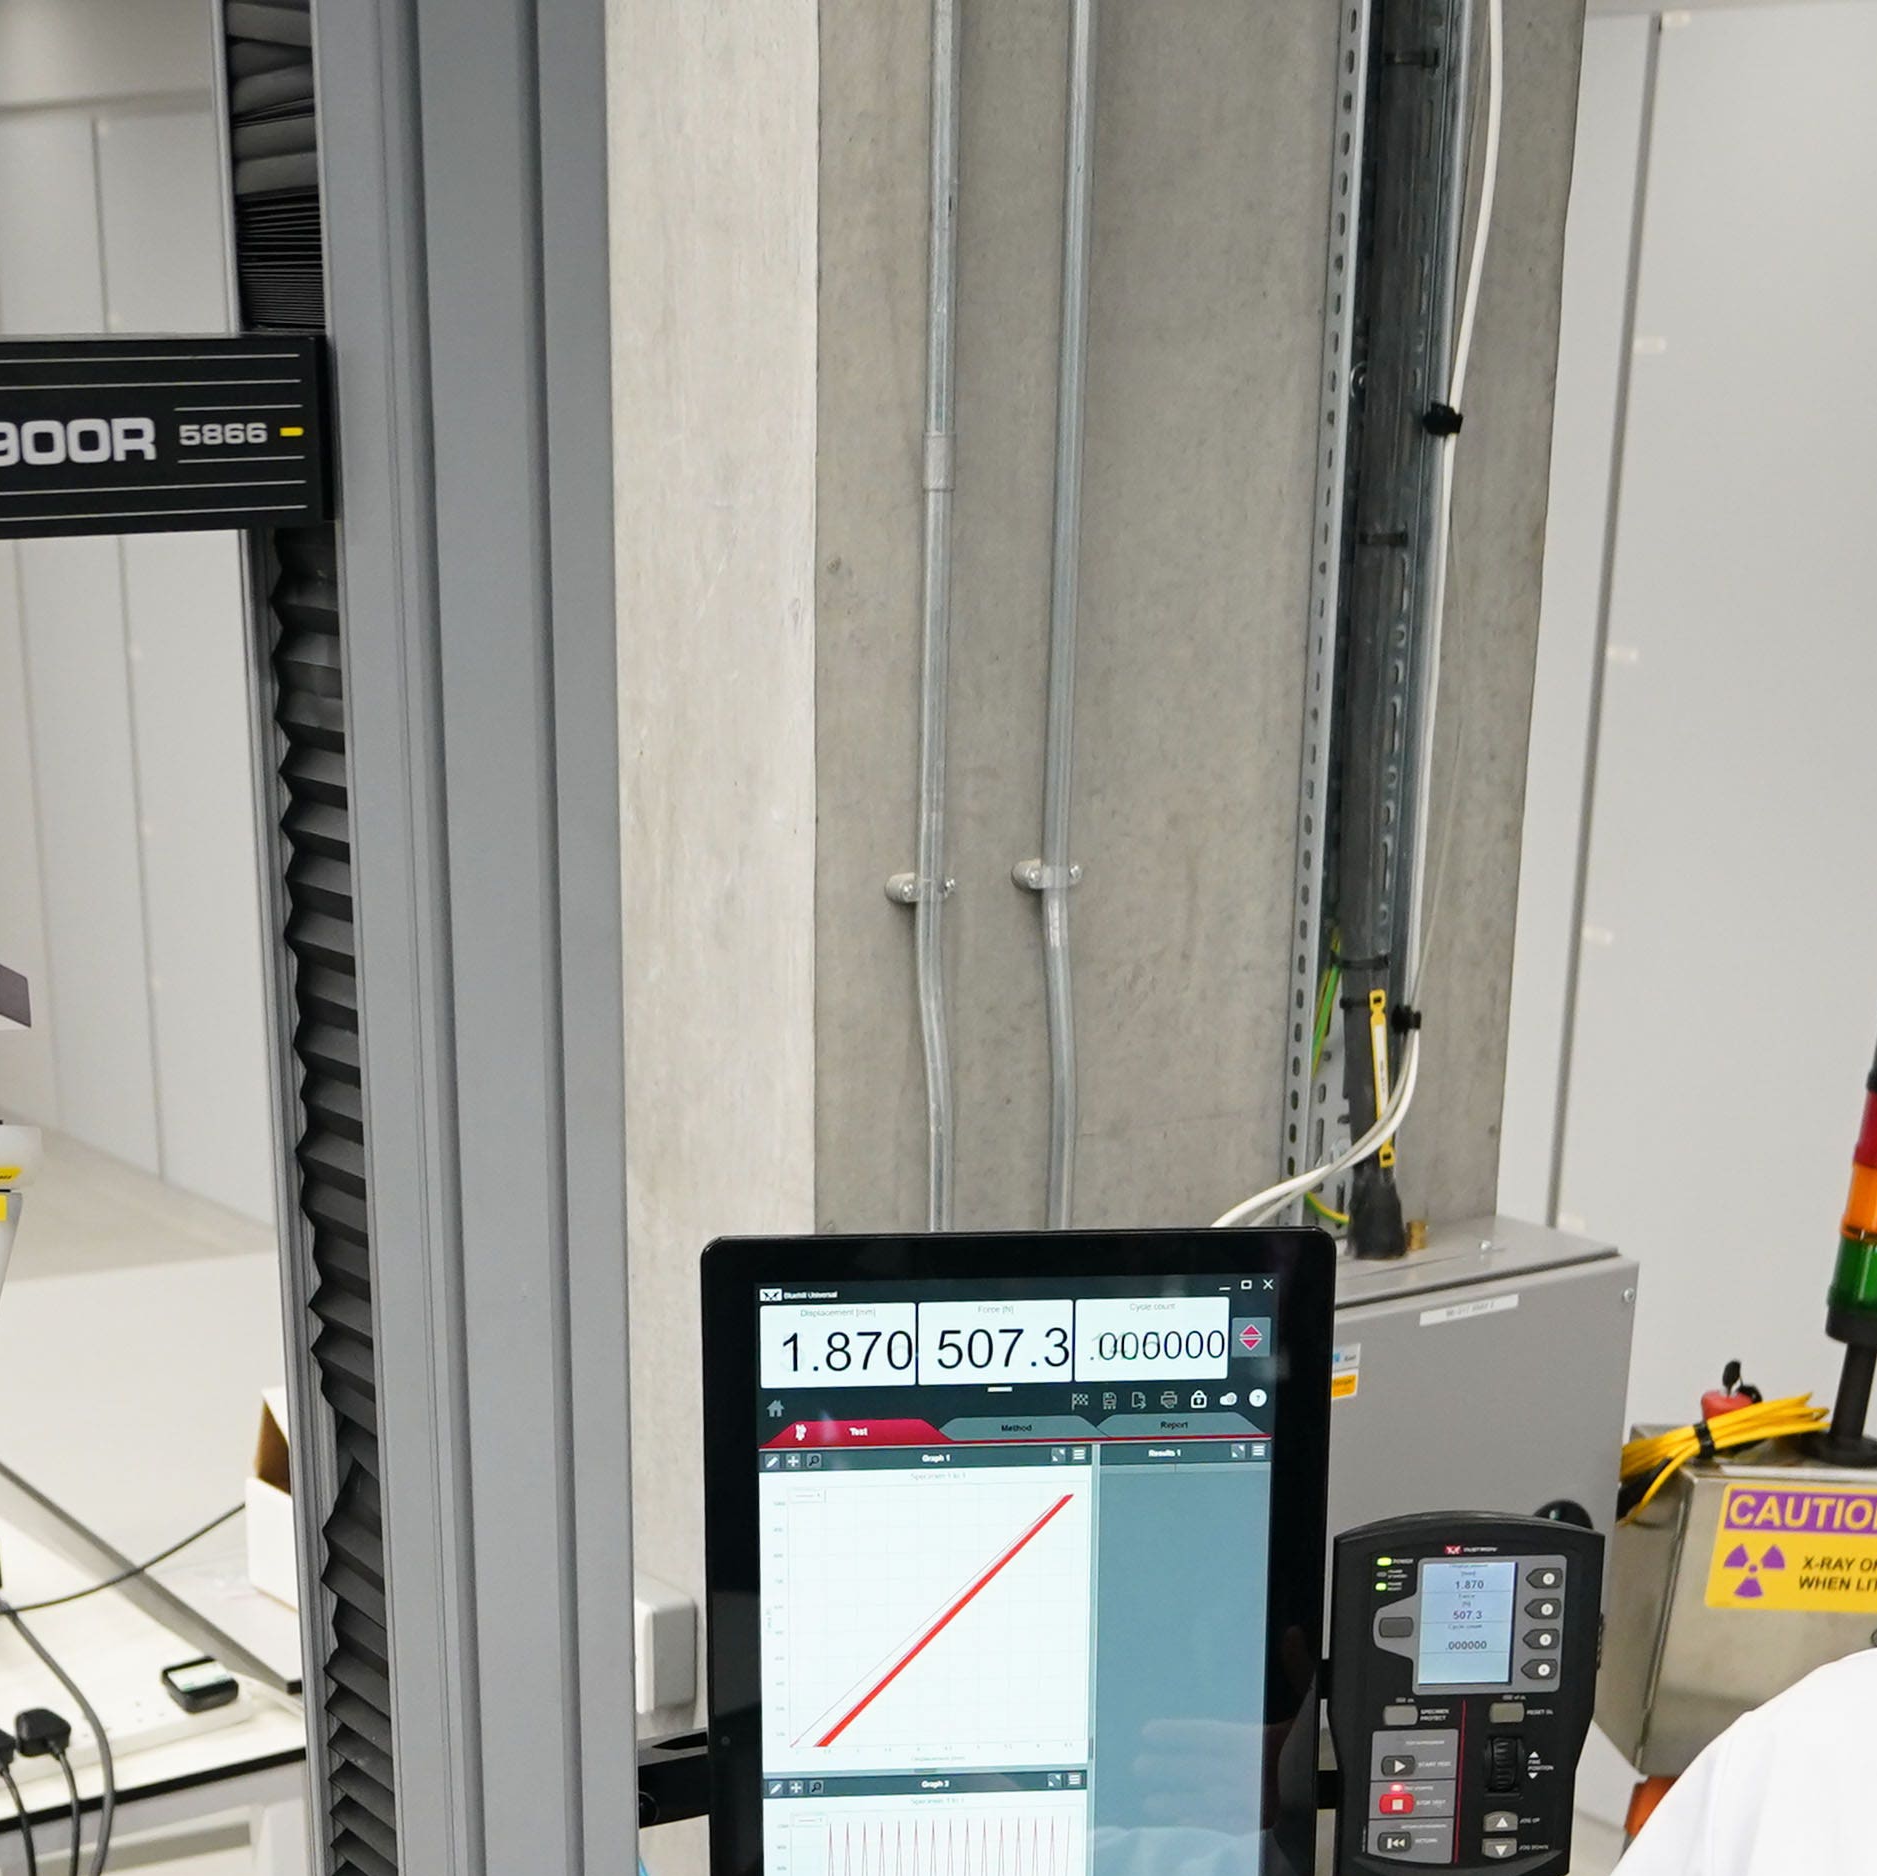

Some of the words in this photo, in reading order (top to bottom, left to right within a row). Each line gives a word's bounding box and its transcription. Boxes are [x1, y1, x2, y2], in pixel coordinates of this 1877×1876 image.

[178, 422, 268, 447] 5866
[808, 1290, 839, 1299] Universal
[977, 1304, 1000, 1314] Force
[1128, 1302, 1154, 1312] Cycle
[1155, 1302, 1176, 1311] count
[800, 1308, 855, 1318] Displacement
[782, 1330, 914, 1373] 1.870
[937, 1327, 1070, 1370] 507.3
[1000, 1422, 1033, 1434] Method
[1160, 1419, 1189, 1432] Report
[849, 1426, 869, 1437] Test
[1148, 1447, 1175, 1458] Results
[921, 1453, 945, 1464] Graph
[1802, 1556, 1856, 1572] X-RAY
[1455, 1580, 1484, 1590] 1.870
[1798, 1576, 1852, 1591] WHEN
[1452, 1610, 1483, 1620] 507.3
[921, 1780, 942, 1790] Graph
